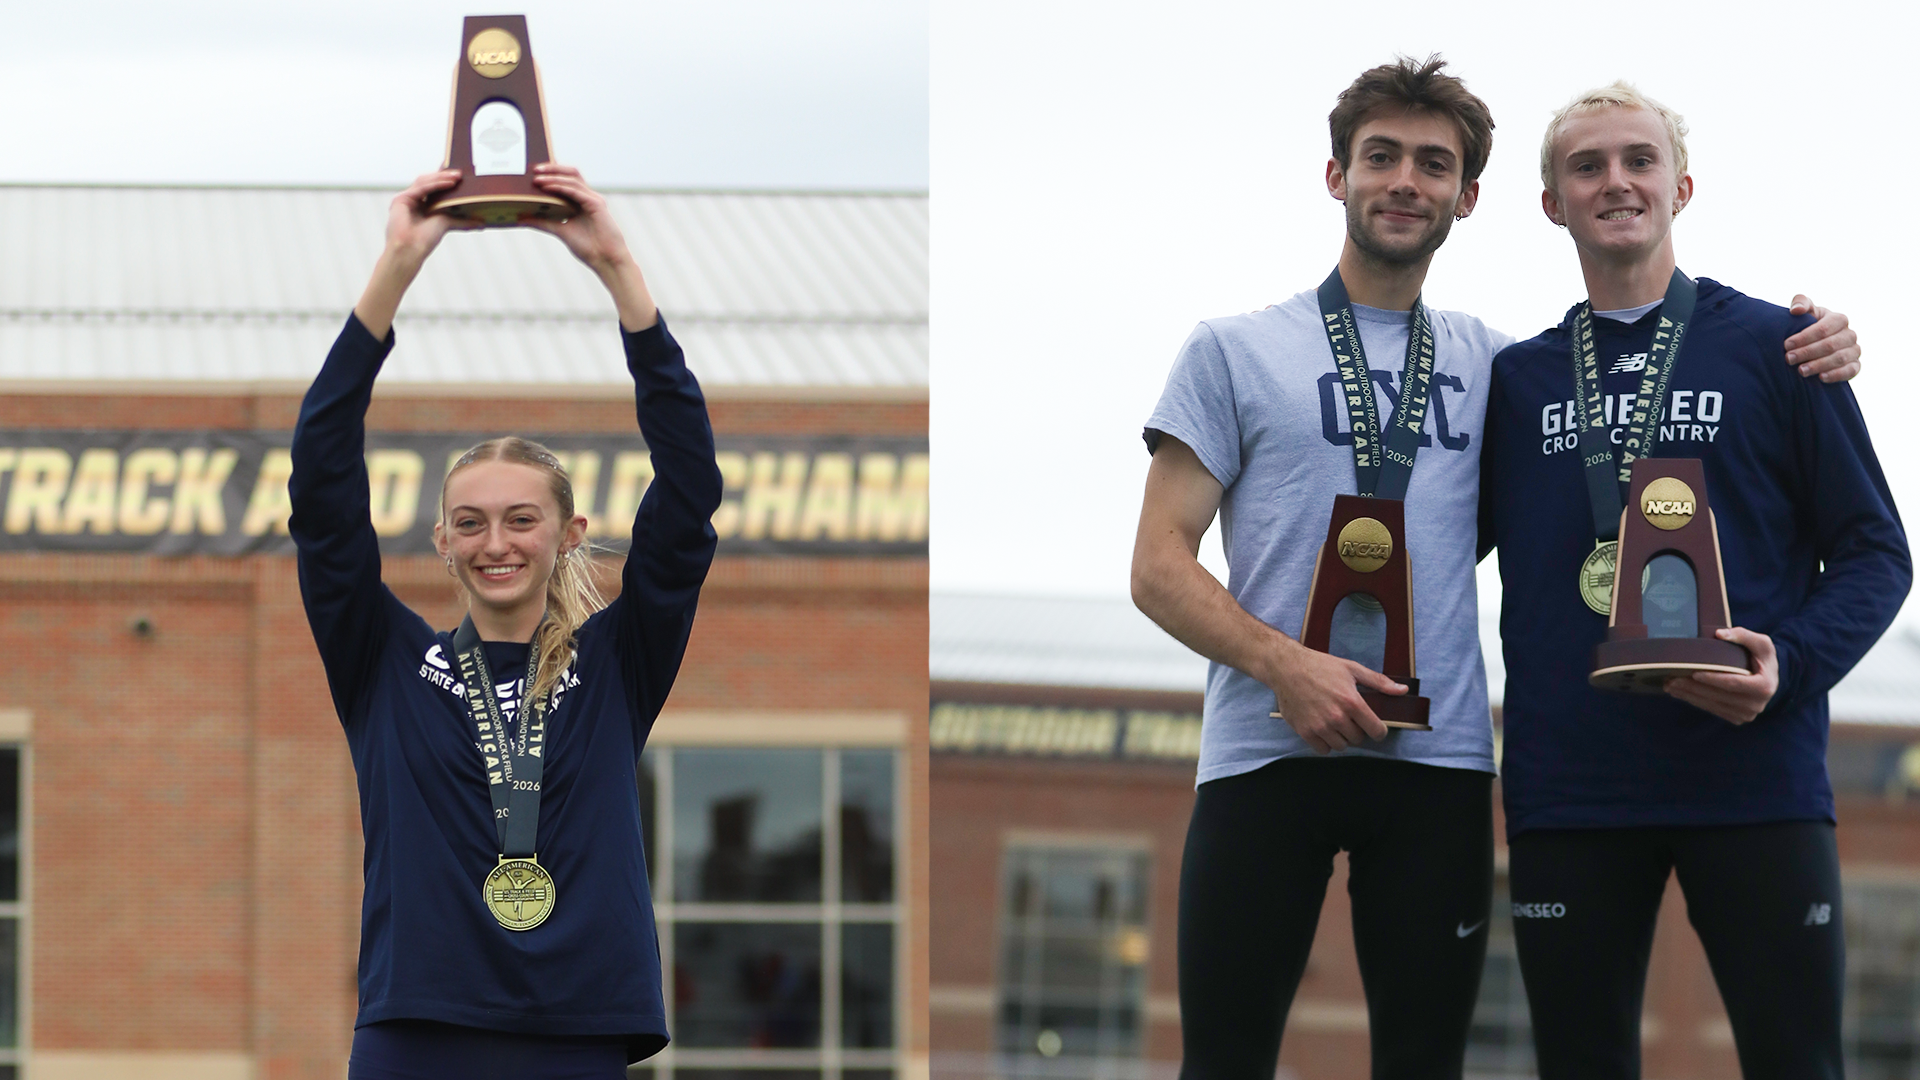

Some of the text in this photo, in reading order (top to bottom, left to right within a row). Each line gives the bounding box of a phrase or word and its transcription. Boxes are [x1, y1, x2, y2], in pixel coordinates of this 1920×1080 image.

[473, 51, 518, 65] NCAA
[1341, 308, 1352, 329] NCAA
[1673, 321, 1684, 342] NCAA
[1346, 328, 1362, 360] DIVISION
[1662, 343, 1679, 376] DIVISION
[1325, 314, 1370, 466] ALL-AMERICAN
[1357, 367, 1373, 407] OUTDOOR
[1396, 404, 1408, 428] NCAA
[1402, 370, 1414, 404] DIVISION
[1409, 328, 1420, 363] OUTDOOR
[1618, 316, 1673, 482] ALL-AMERICAN
[1647, 383, 1666, 426] OUTDOOR
[1367, 408, 1377, 435] TRACK
[1541, 390, 1723, 436] GEEEO
[1579, 410, 1588, 433] NCAA
[1542, 424, 1719, 455] CRO CNTRY
[1641, 427, 1655, 454] TRACK
[1371, 443, 1380, 467] FIELD
[1386, 449, 1414, 467] 2026
[1585, 451, 1612, 467] 2026
[240, 447, 424, 537] AD
[1645, 500, 1694, 516] NCAA
[1341, 541, 1391, 559] NCAA
[419, 664, 454, 690] STATE
[458, 652, 503, 785] ALL-AMERICAN
[487, 697, 502, 730] OUTDOOR
[496, 730, 509, 756] TRACK
[518, 735, 526, 757] NCAA
[513, 780, 540, 791] 2026
[495, 807, 509, 819] 20
[493, 861, 546, 880] ALL-AMERICAN
